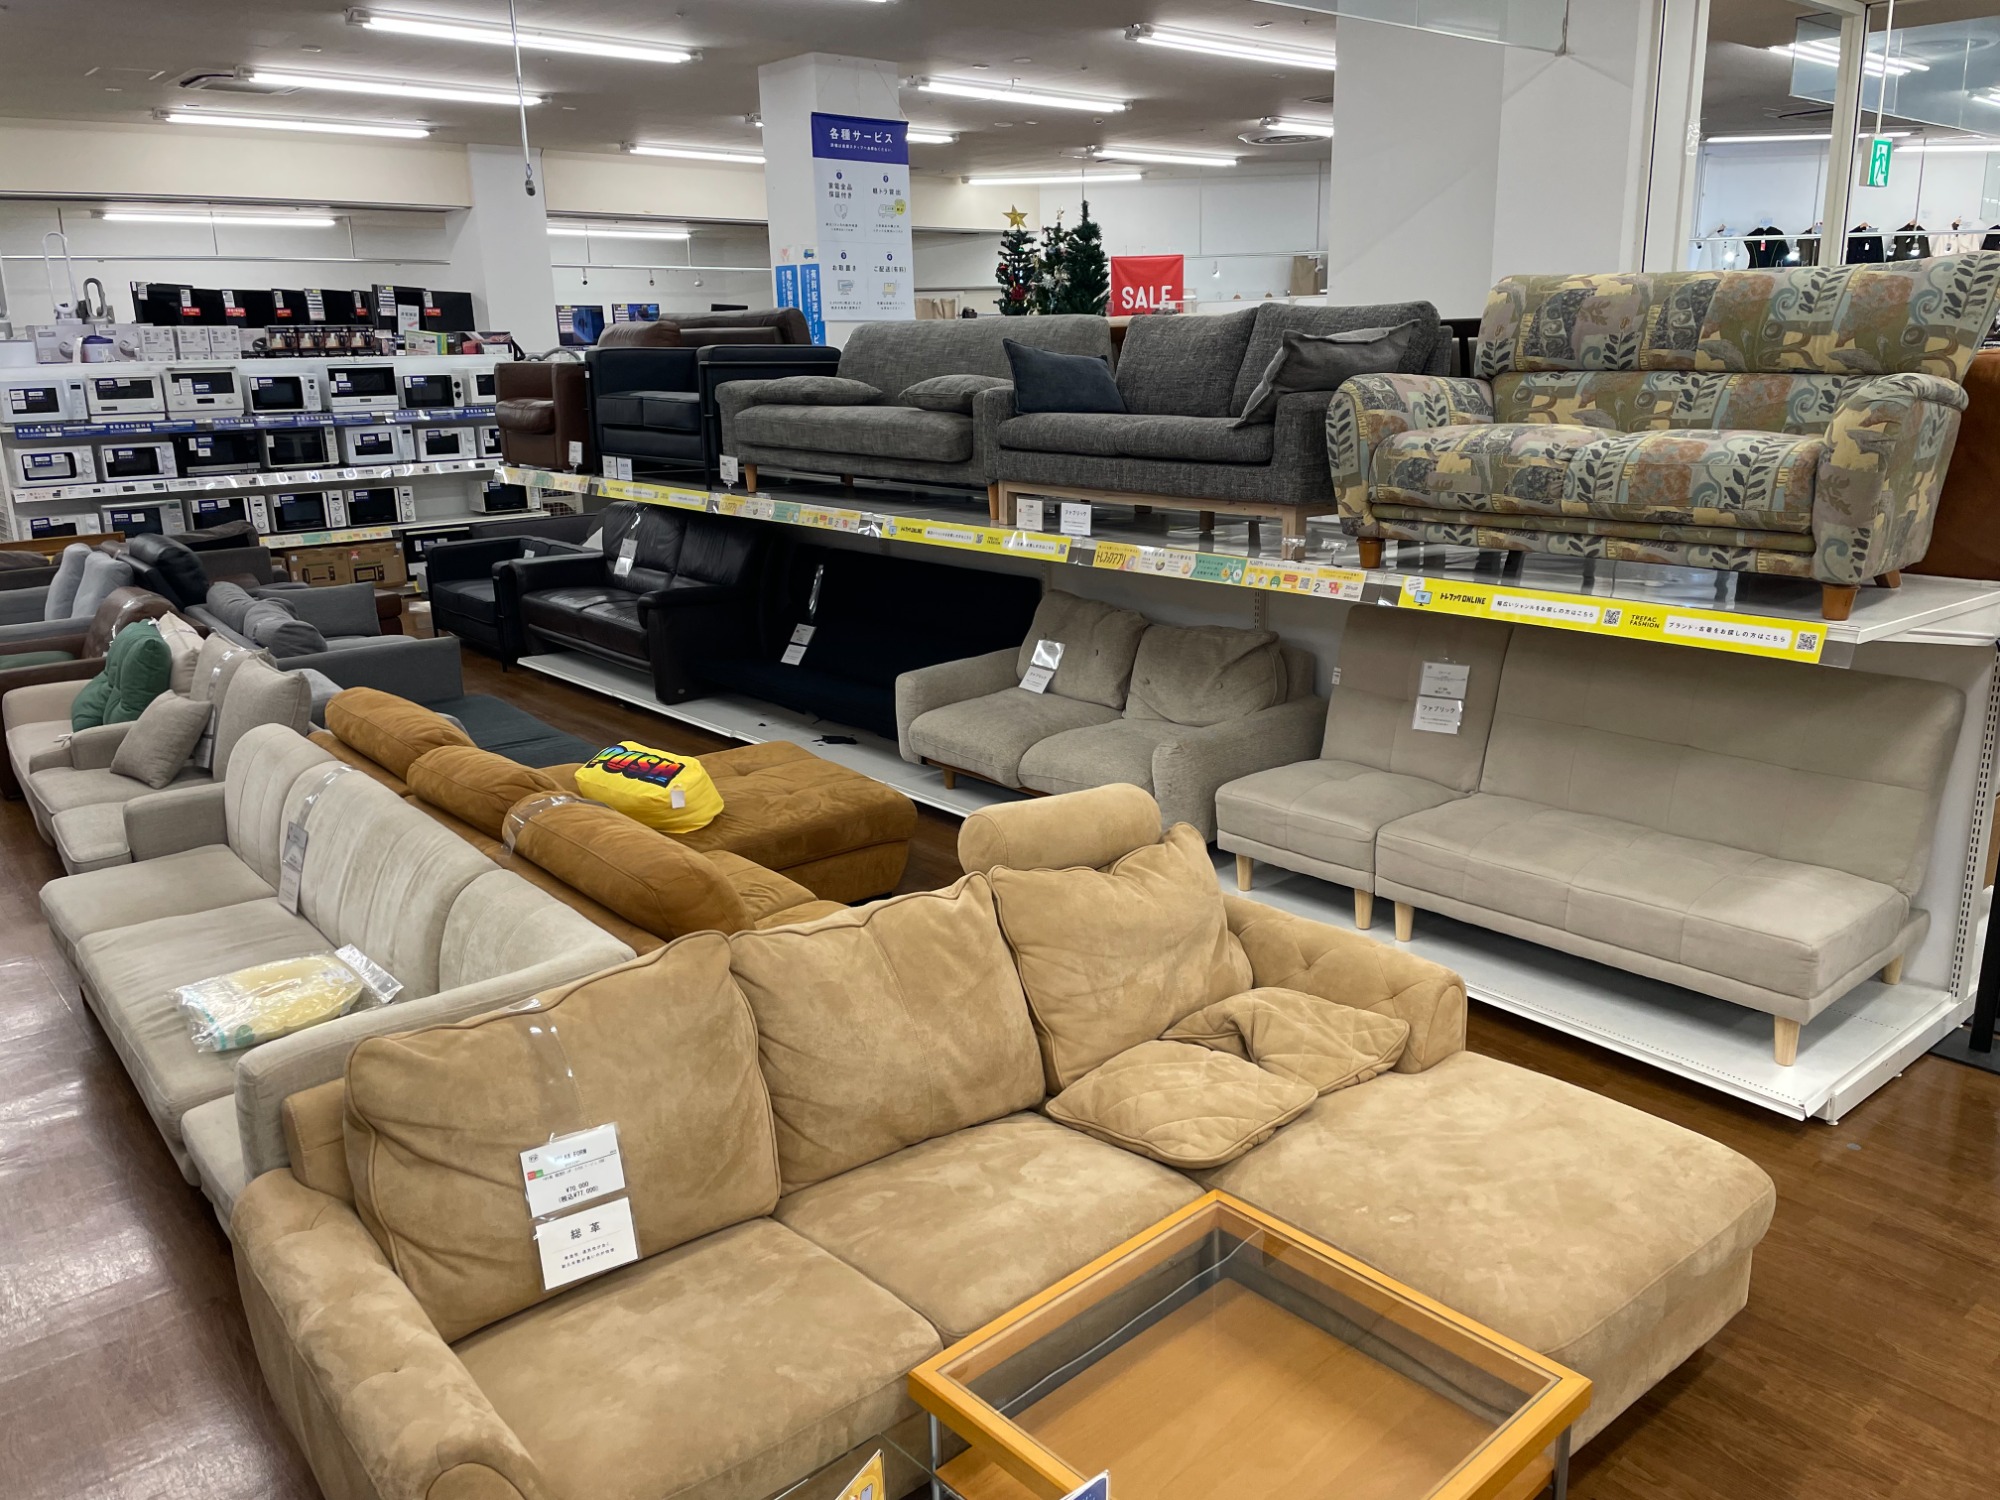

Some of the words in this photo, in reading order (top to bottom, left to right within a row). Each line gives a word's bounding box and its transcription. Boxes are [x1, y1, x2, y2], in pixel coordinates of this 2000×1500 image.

[829, 127, 893, 144] 各種サービス
[1122, 285, 1173, 310] SALE
[1497, 600, 1594, 619] 幅広いジャンルをお探しの方はこちら
[1630, 619, 1660, 629] FASHION
[1631, 614, 1657, 623] TREFAC
[1422, 704, 1456, 713] ファブリック
[585, 745, 686, 788] PUSH
